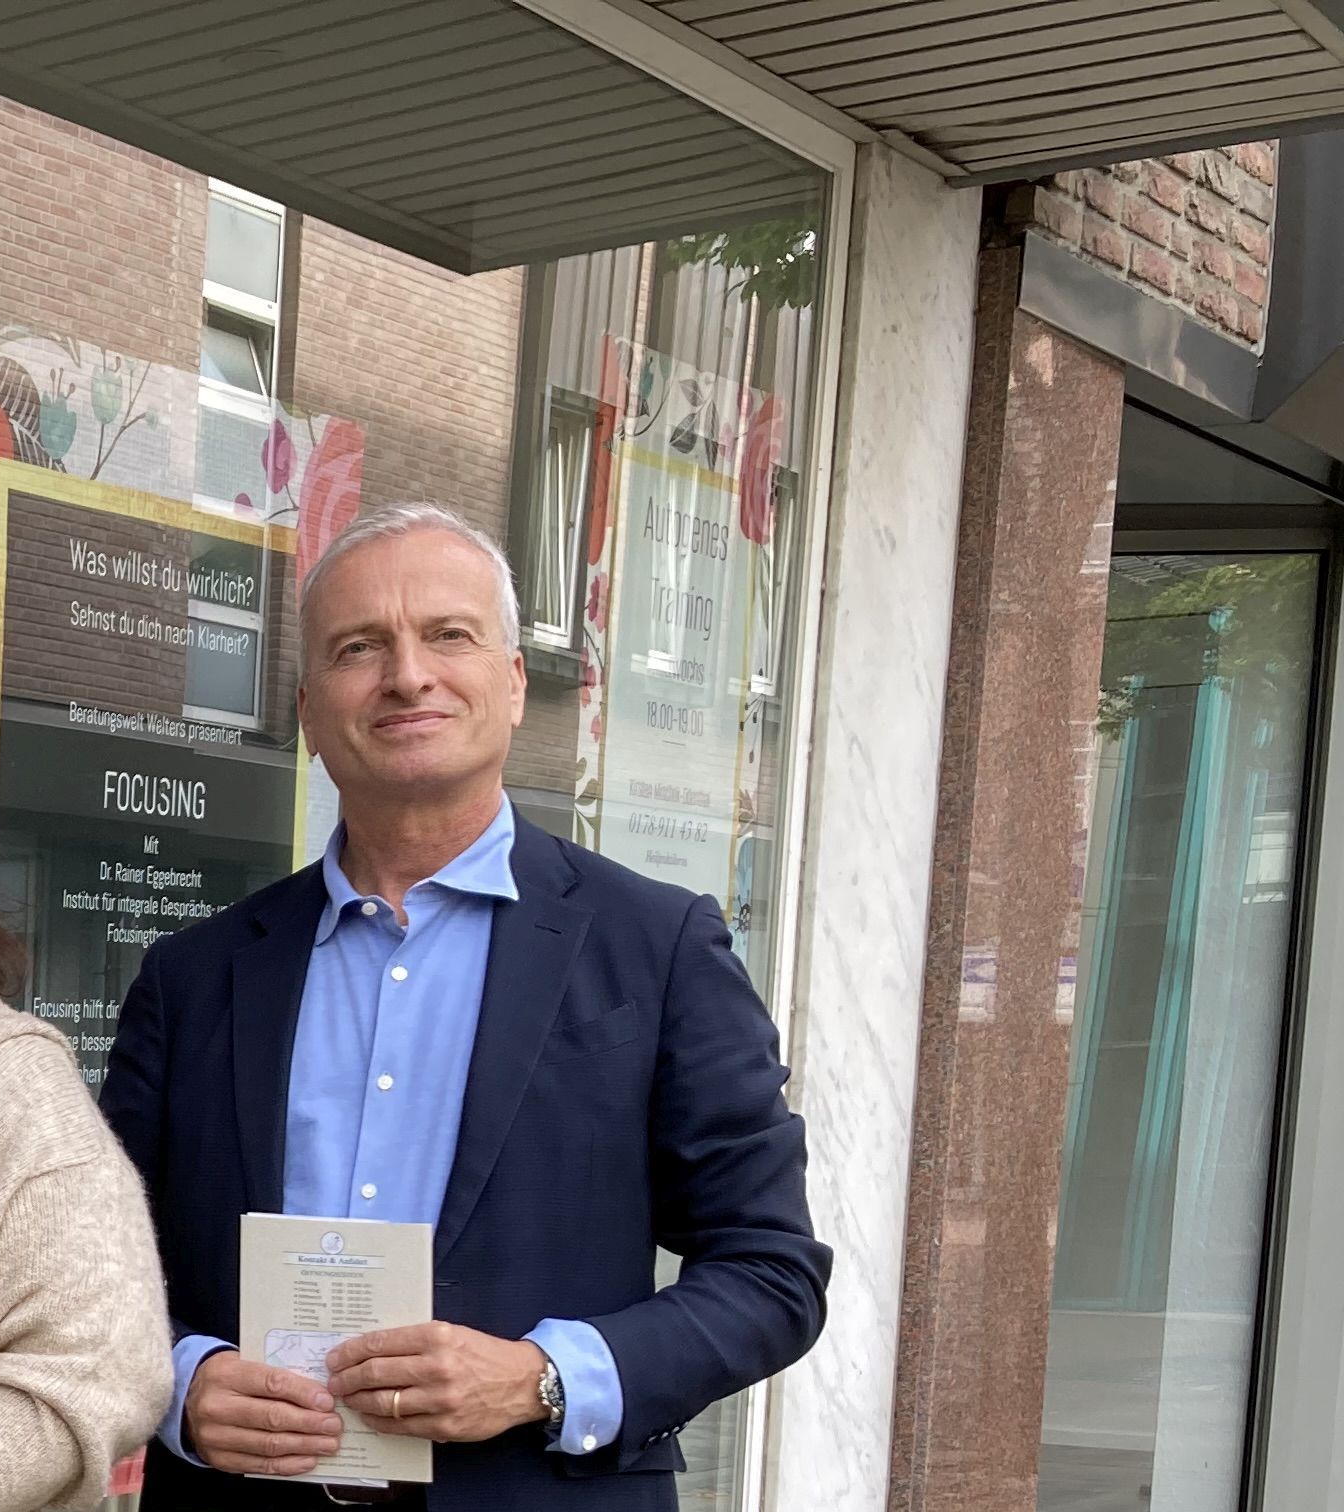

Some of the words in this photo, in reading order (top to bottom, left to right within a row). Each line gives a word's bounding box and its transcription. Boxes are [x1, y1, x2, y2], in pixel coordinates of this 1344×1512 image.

[69, 538, 107, 577] Was
[112, 551, 158, 587] willst
[162, 559, 181, 592] du
[186, 567, 255, 607] wirklich?
[70, 600, 115, 632] Sehnst
[119, 610, 134, 636] du
[138, 614, 162, 641] dich
[165, 623, 194, 646] nach
[198, 625, 249, 656] Klarheit?
[69, 701, 144, 733] Beratungswelt
[146, 713, 186, 738] Welters
[188, 723, 243, 746] präsentiert
[646, 701, 704, 737] 18.00-19.00
[103, 770, 207, 820] FOCUSING
[143, 835, 160, 855] Mit
[99, 861, 113, 881] Dr.
[115, 862, 145, 884] Rainer
[146, 865, 202, 890] Eggebrecht
[63, 889, 99, 910] Institut
[101, 892, 115, 911] für
[117, 893, 159, 918] integrale
[160, 897, 215, 921] Gesprächs-
[33, 997, 81, 1023] Focusing
[83, 999, 103, 1019] hilft
